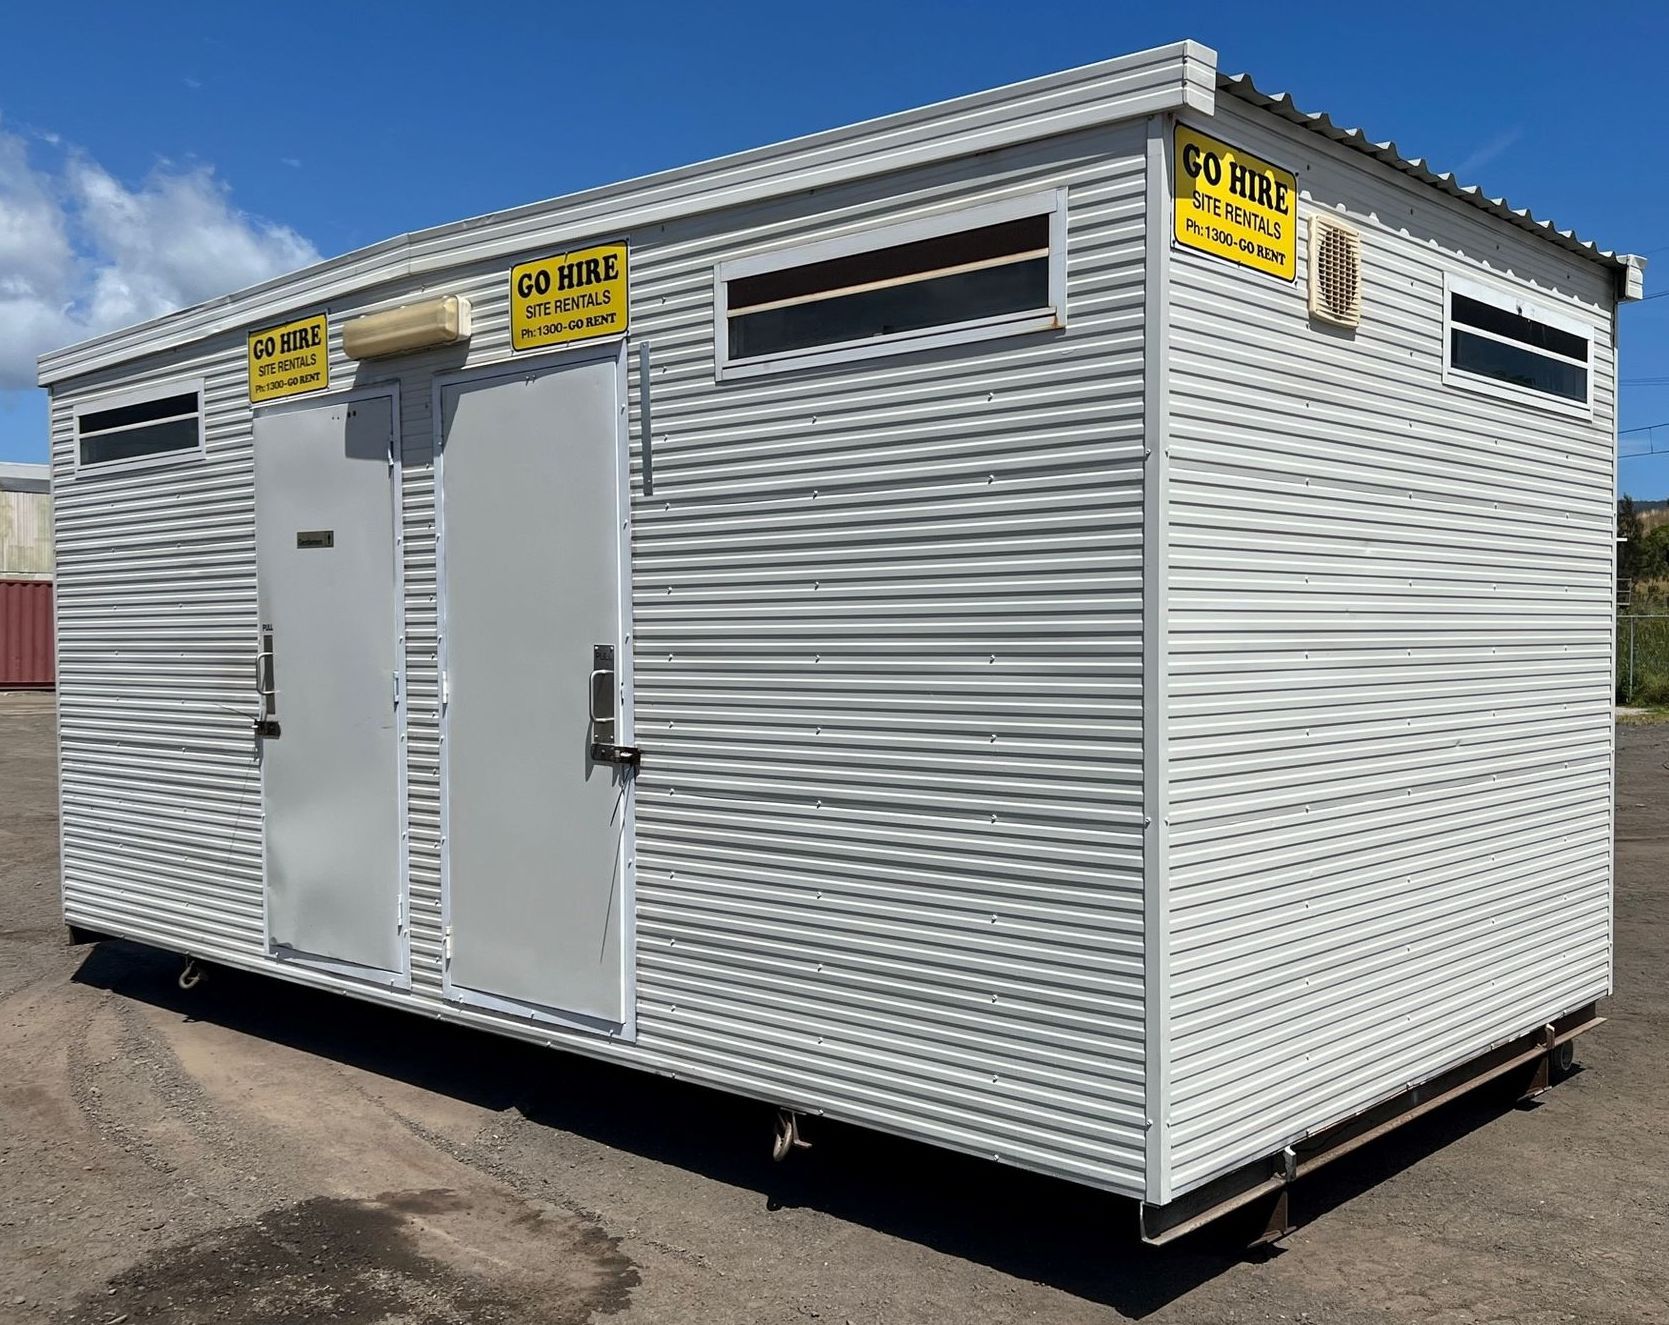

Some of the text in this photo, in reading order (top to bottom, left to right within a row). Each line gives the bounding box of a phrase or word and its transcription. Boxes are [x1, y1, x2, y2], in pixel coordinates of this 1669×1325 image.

[1183, 143, 1289, 216] GO HIRE
[1192, 190, 1281, 240] SITE RENTALS
[1257, 244, 1286, 266] RENT
[518, 253, 619, 298] GO HIRE
[526, 290, 611, 319] SITE RENTALS
[586, 312, 616, 328] RENT
[254, 324, 321, 360] GO HIRE
[259, 354, 317, 377] SITE RENTALS
[300, 372, 320, 384] RENT
